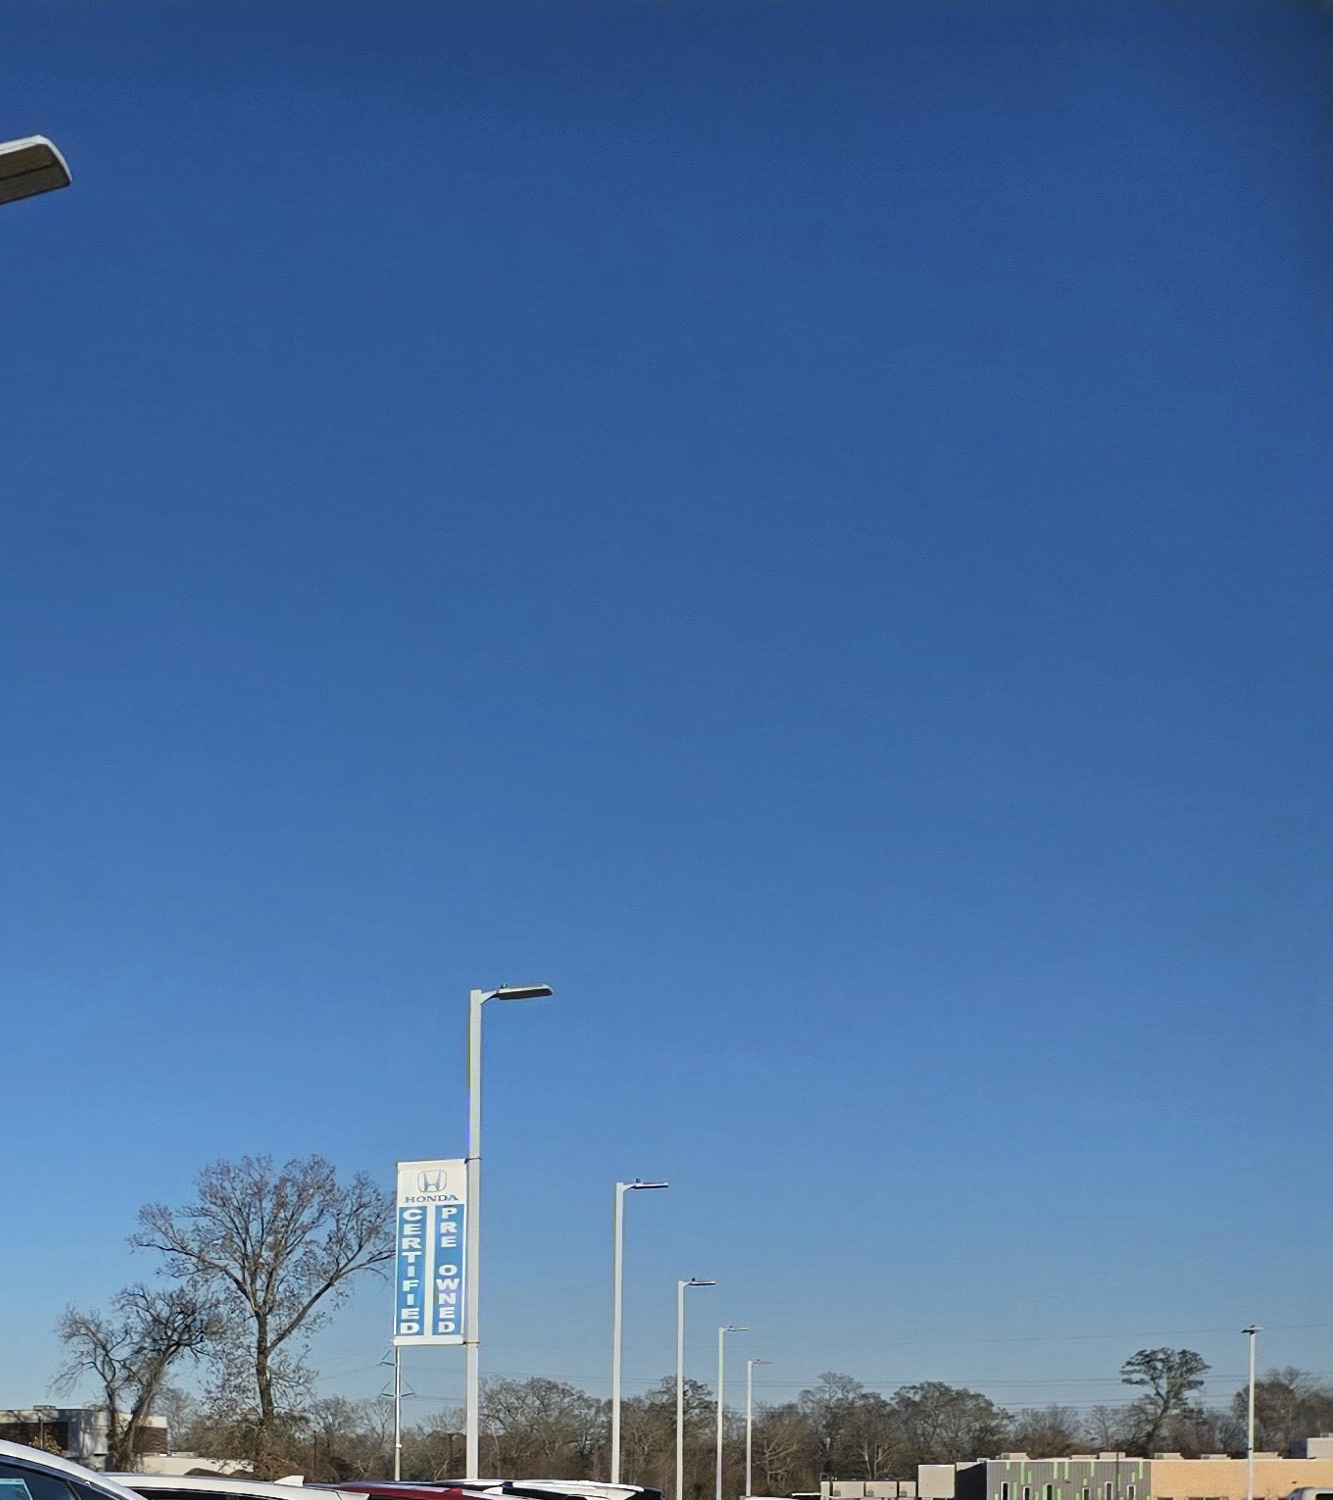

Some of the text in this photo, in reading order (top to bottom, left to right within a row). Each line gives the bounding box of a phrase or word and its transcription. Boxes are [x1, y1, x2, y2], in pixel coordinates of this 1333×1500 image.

[405, 1194, 458, 1203] HONDA
[401, 1209, 423, 1334] CERTIFIED
[436, 1207, 459, 1332] PRE OWNED
